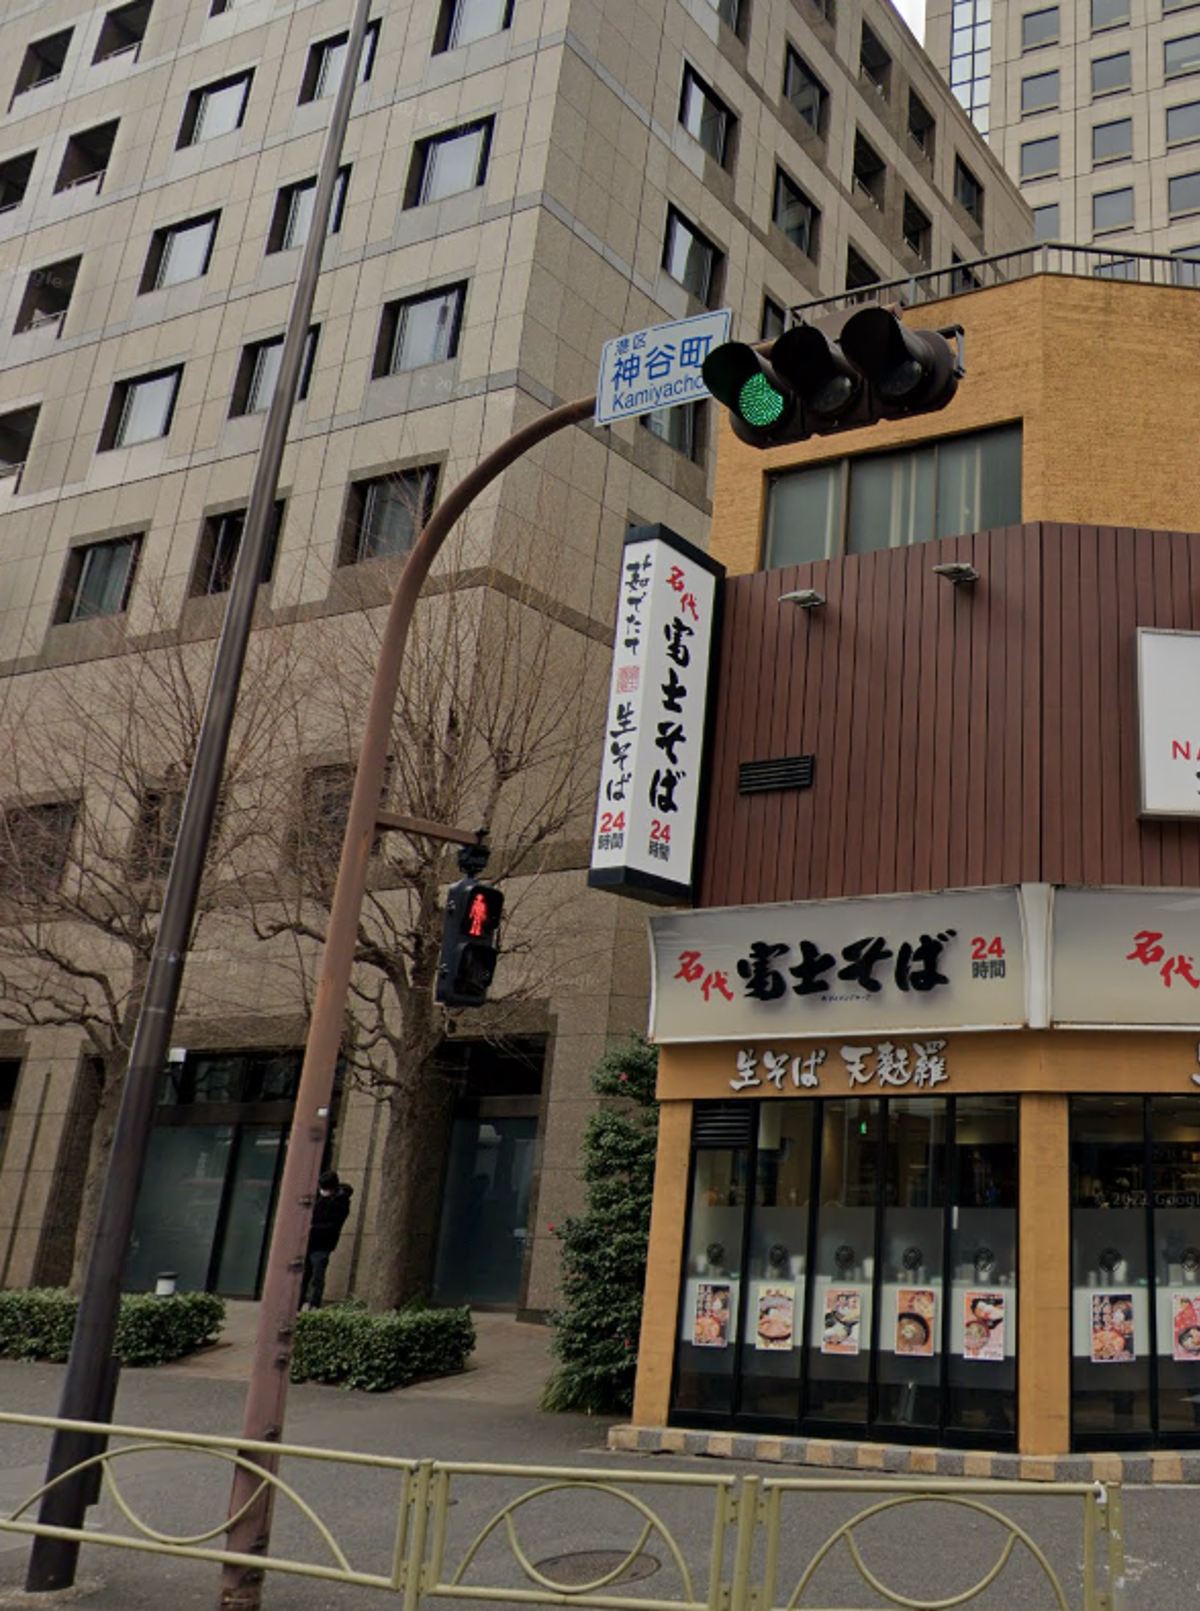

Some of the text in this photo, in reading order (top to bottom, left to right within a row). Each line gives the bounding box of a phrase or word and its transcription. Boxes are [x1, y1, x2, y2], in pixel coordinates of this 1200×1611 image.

[614, 331, 648, 356] 港区
[611, 335, 714, 391] 神谷町
[612, 373, 704, 411] Kamiyacho
[665, 565, 699, 621] 名代
[606, 701, 638, 802] 生そば
[600, 810, 626, 833] 24
[650, 819, 672, 844] 24
[597, 832, 624, 851] 時間
[648, 840, 671, 862] 時間
[970, 936, 1006, 960] 24
[674, 950, 735, 1002] 名代
[971, 959, 1006, 980] 時間
[729, 1049, 827, 1092] 生そば
